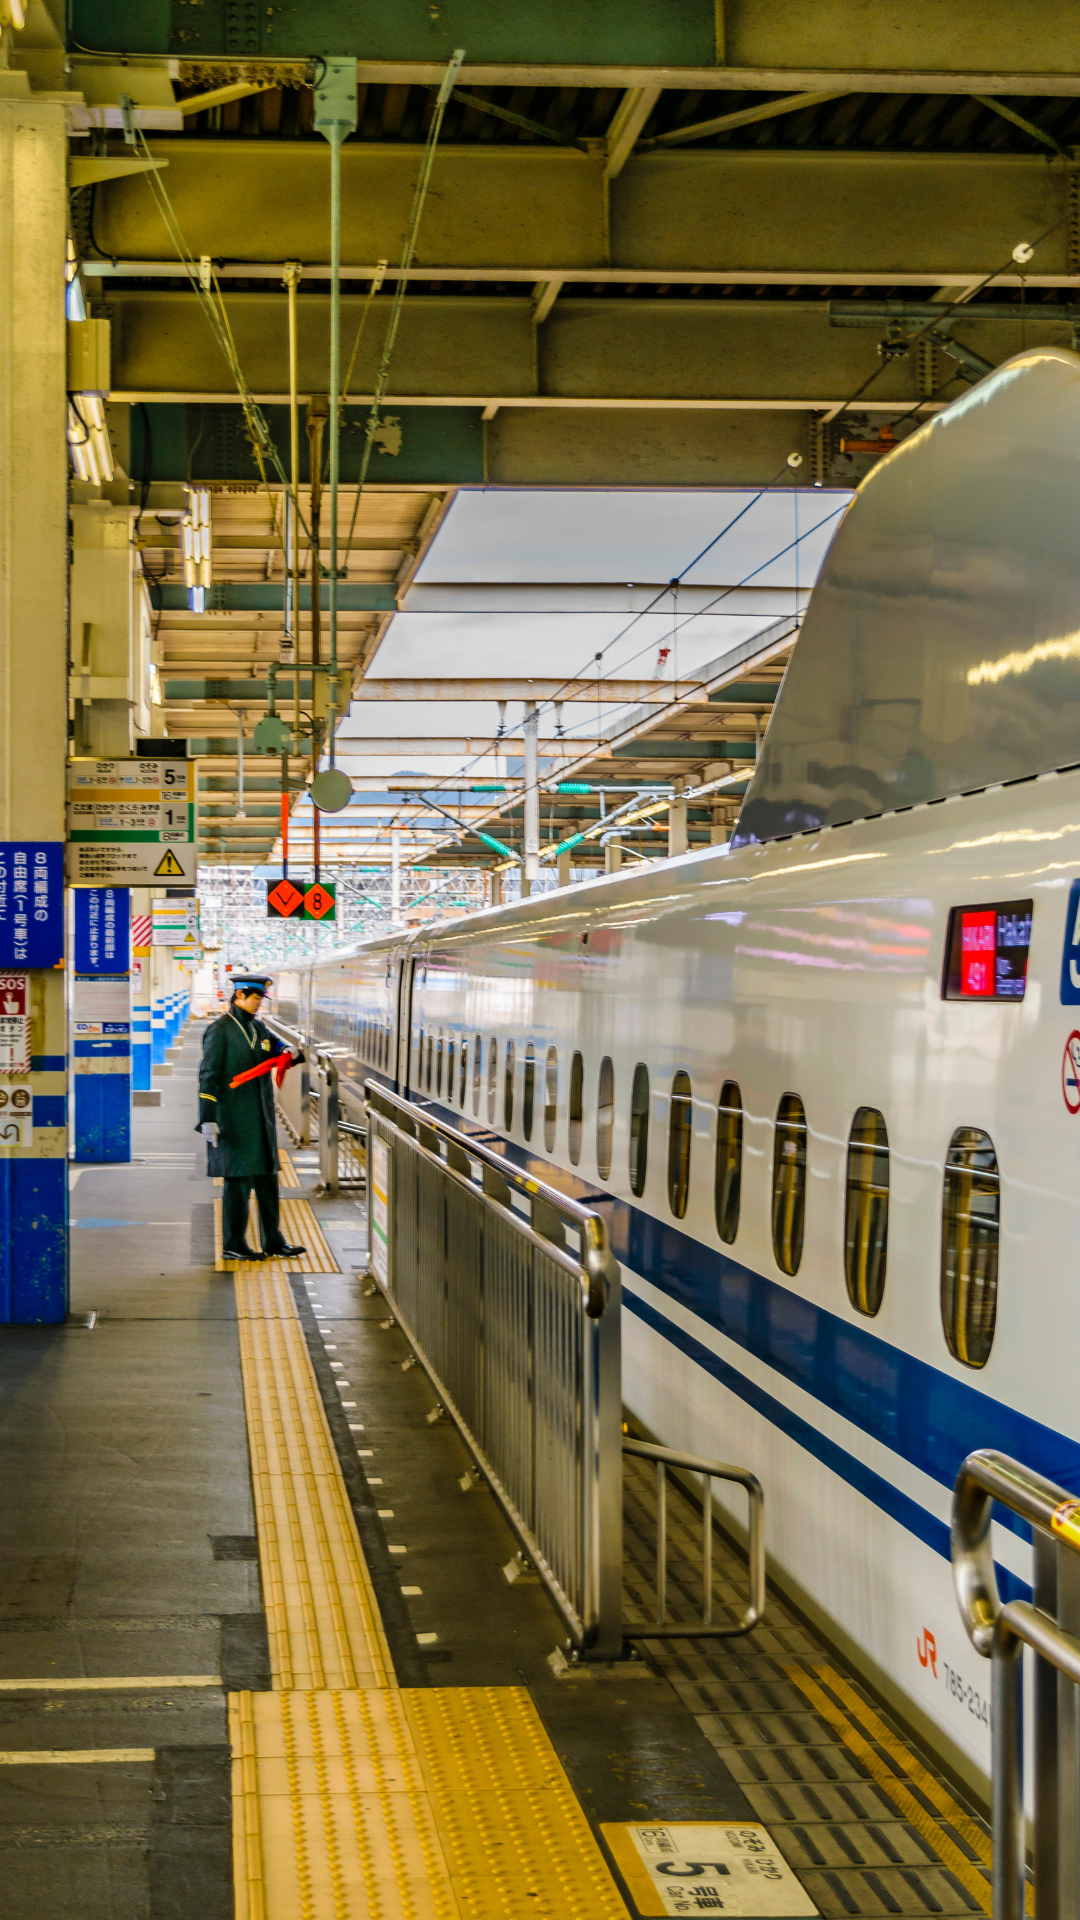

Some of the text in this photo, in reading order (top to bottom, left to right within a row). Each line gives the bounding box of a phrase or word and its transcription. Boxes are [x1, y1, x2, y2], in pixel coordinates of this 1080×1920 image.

[164, 769, 175, 784] 5
[165, 810, 173, 825] 1
[33, 852, 49, 922] 8両編成の
[313, 893, 322, 910] 8
[0, 978, 26, 990] SOS
[916, 1626, 938, 1680] JR
[640, 1826, 666, 1837] 16
[739, 1830, 766, 1852] のぞみ
[754, 1858, 783, 1880] ひかり
[656, 1861, 731, 1909] 5 号車
[666, 1885, 685, 1899] Car
